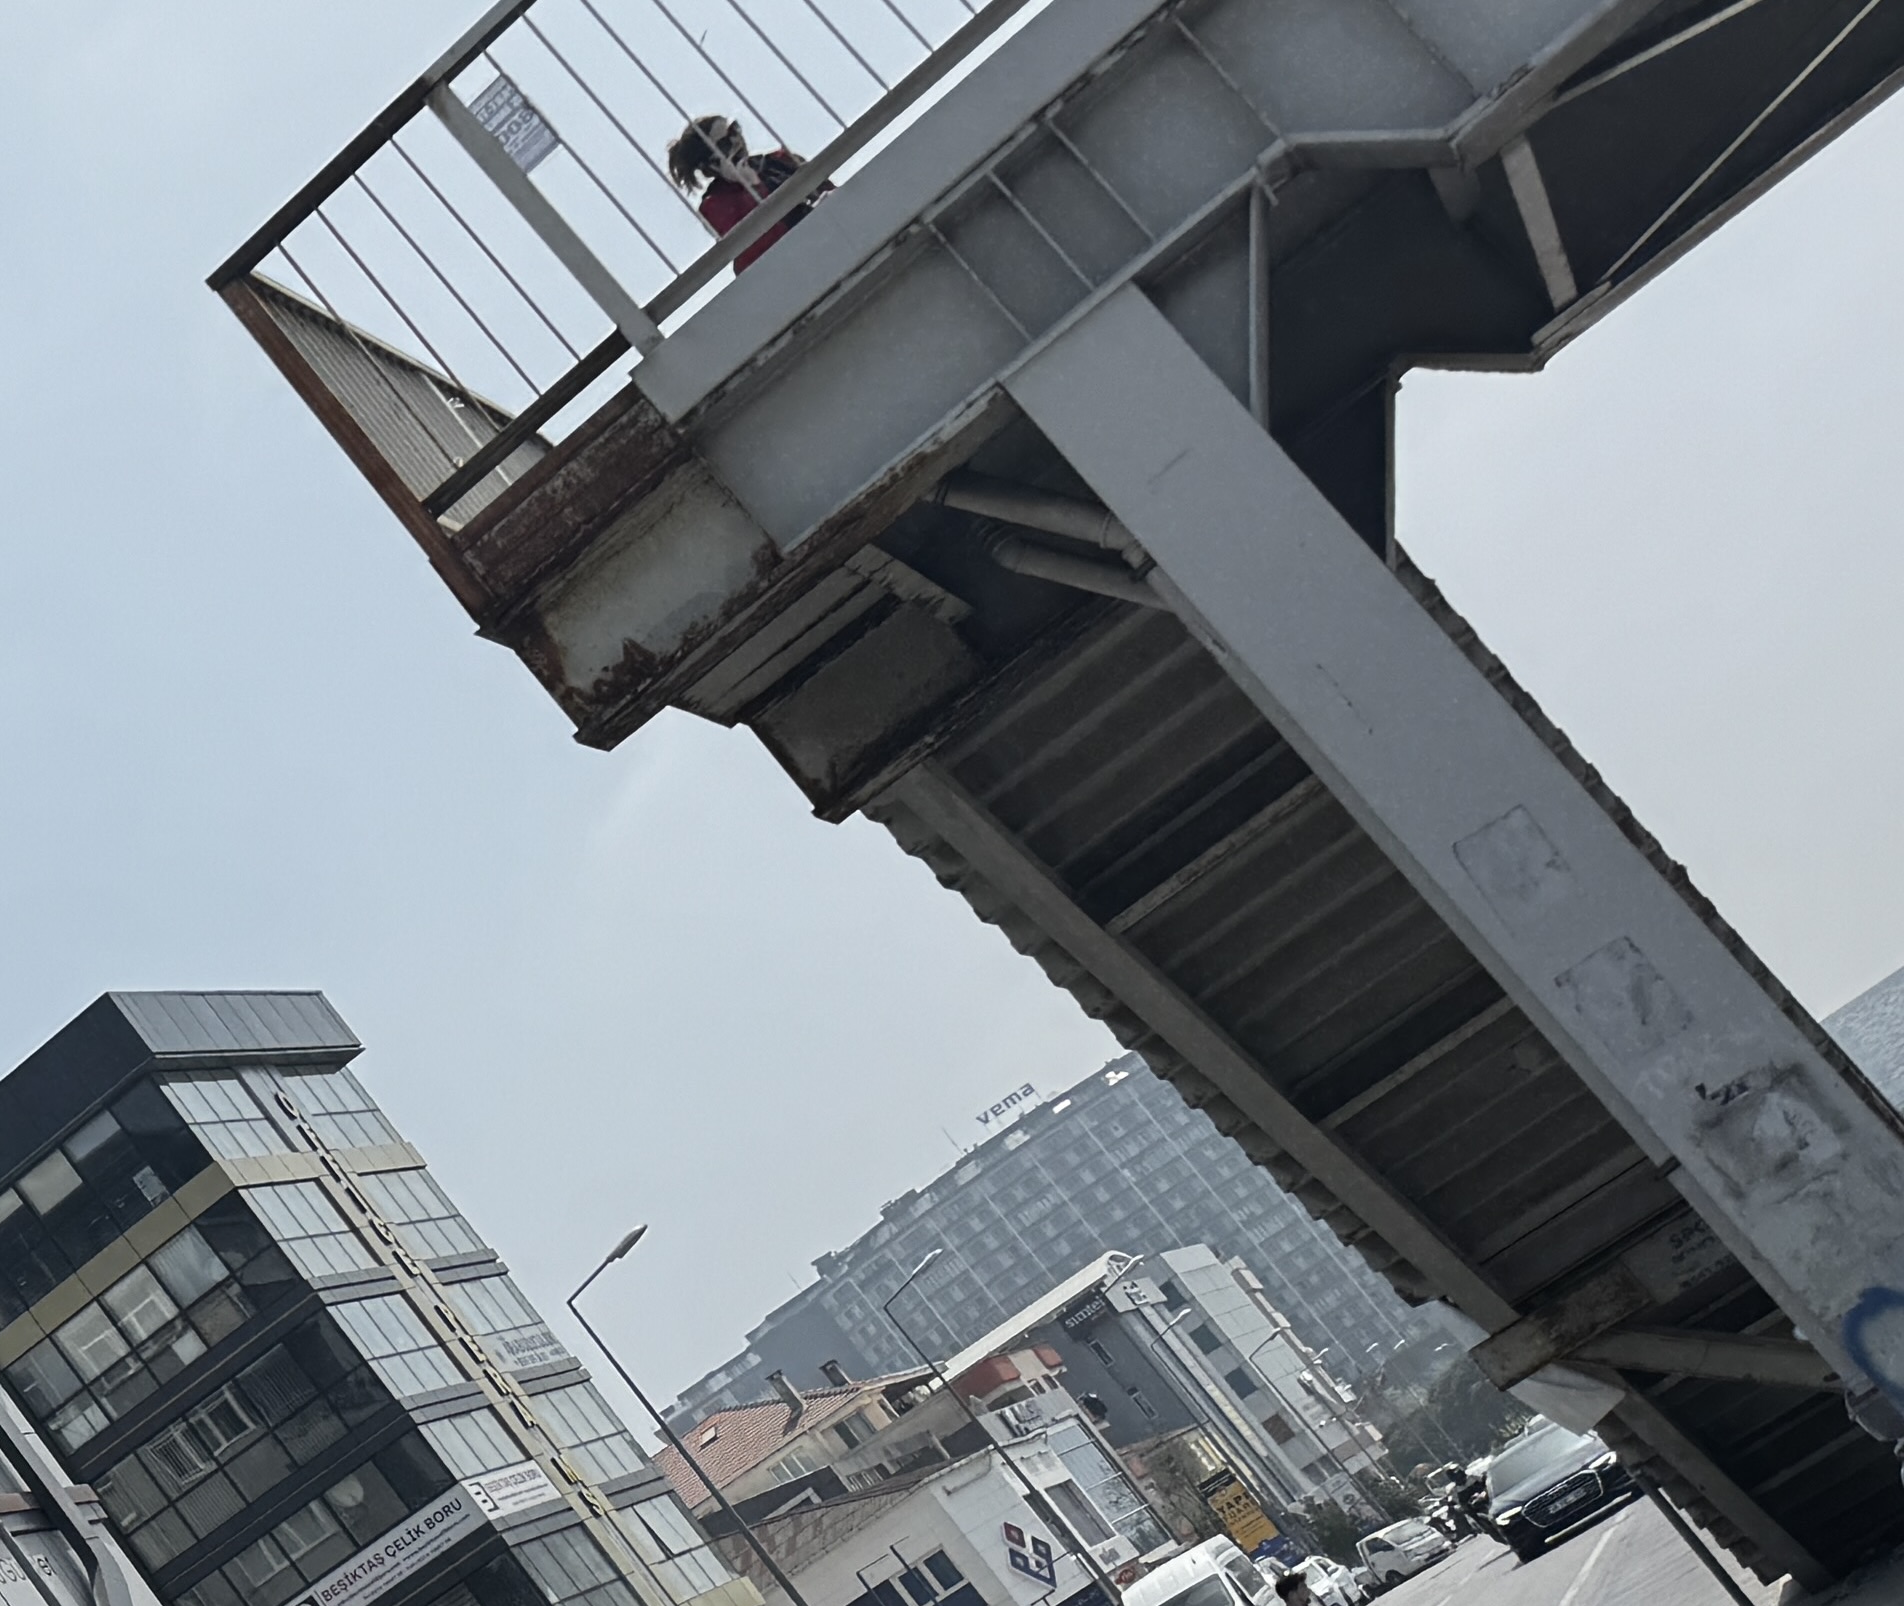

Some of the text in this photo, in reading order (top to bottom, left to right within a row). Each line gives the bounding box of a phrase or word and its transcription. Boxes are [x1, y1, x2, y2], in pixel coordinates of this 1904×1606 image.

[975, 1082, 1035, 1124] vema
[322, 1552, 385, 1602] BEŞİKTAŞ
[384, 1525, 425, 1557] ÇELİK
[425, 1498, 463, 1530] BORU
